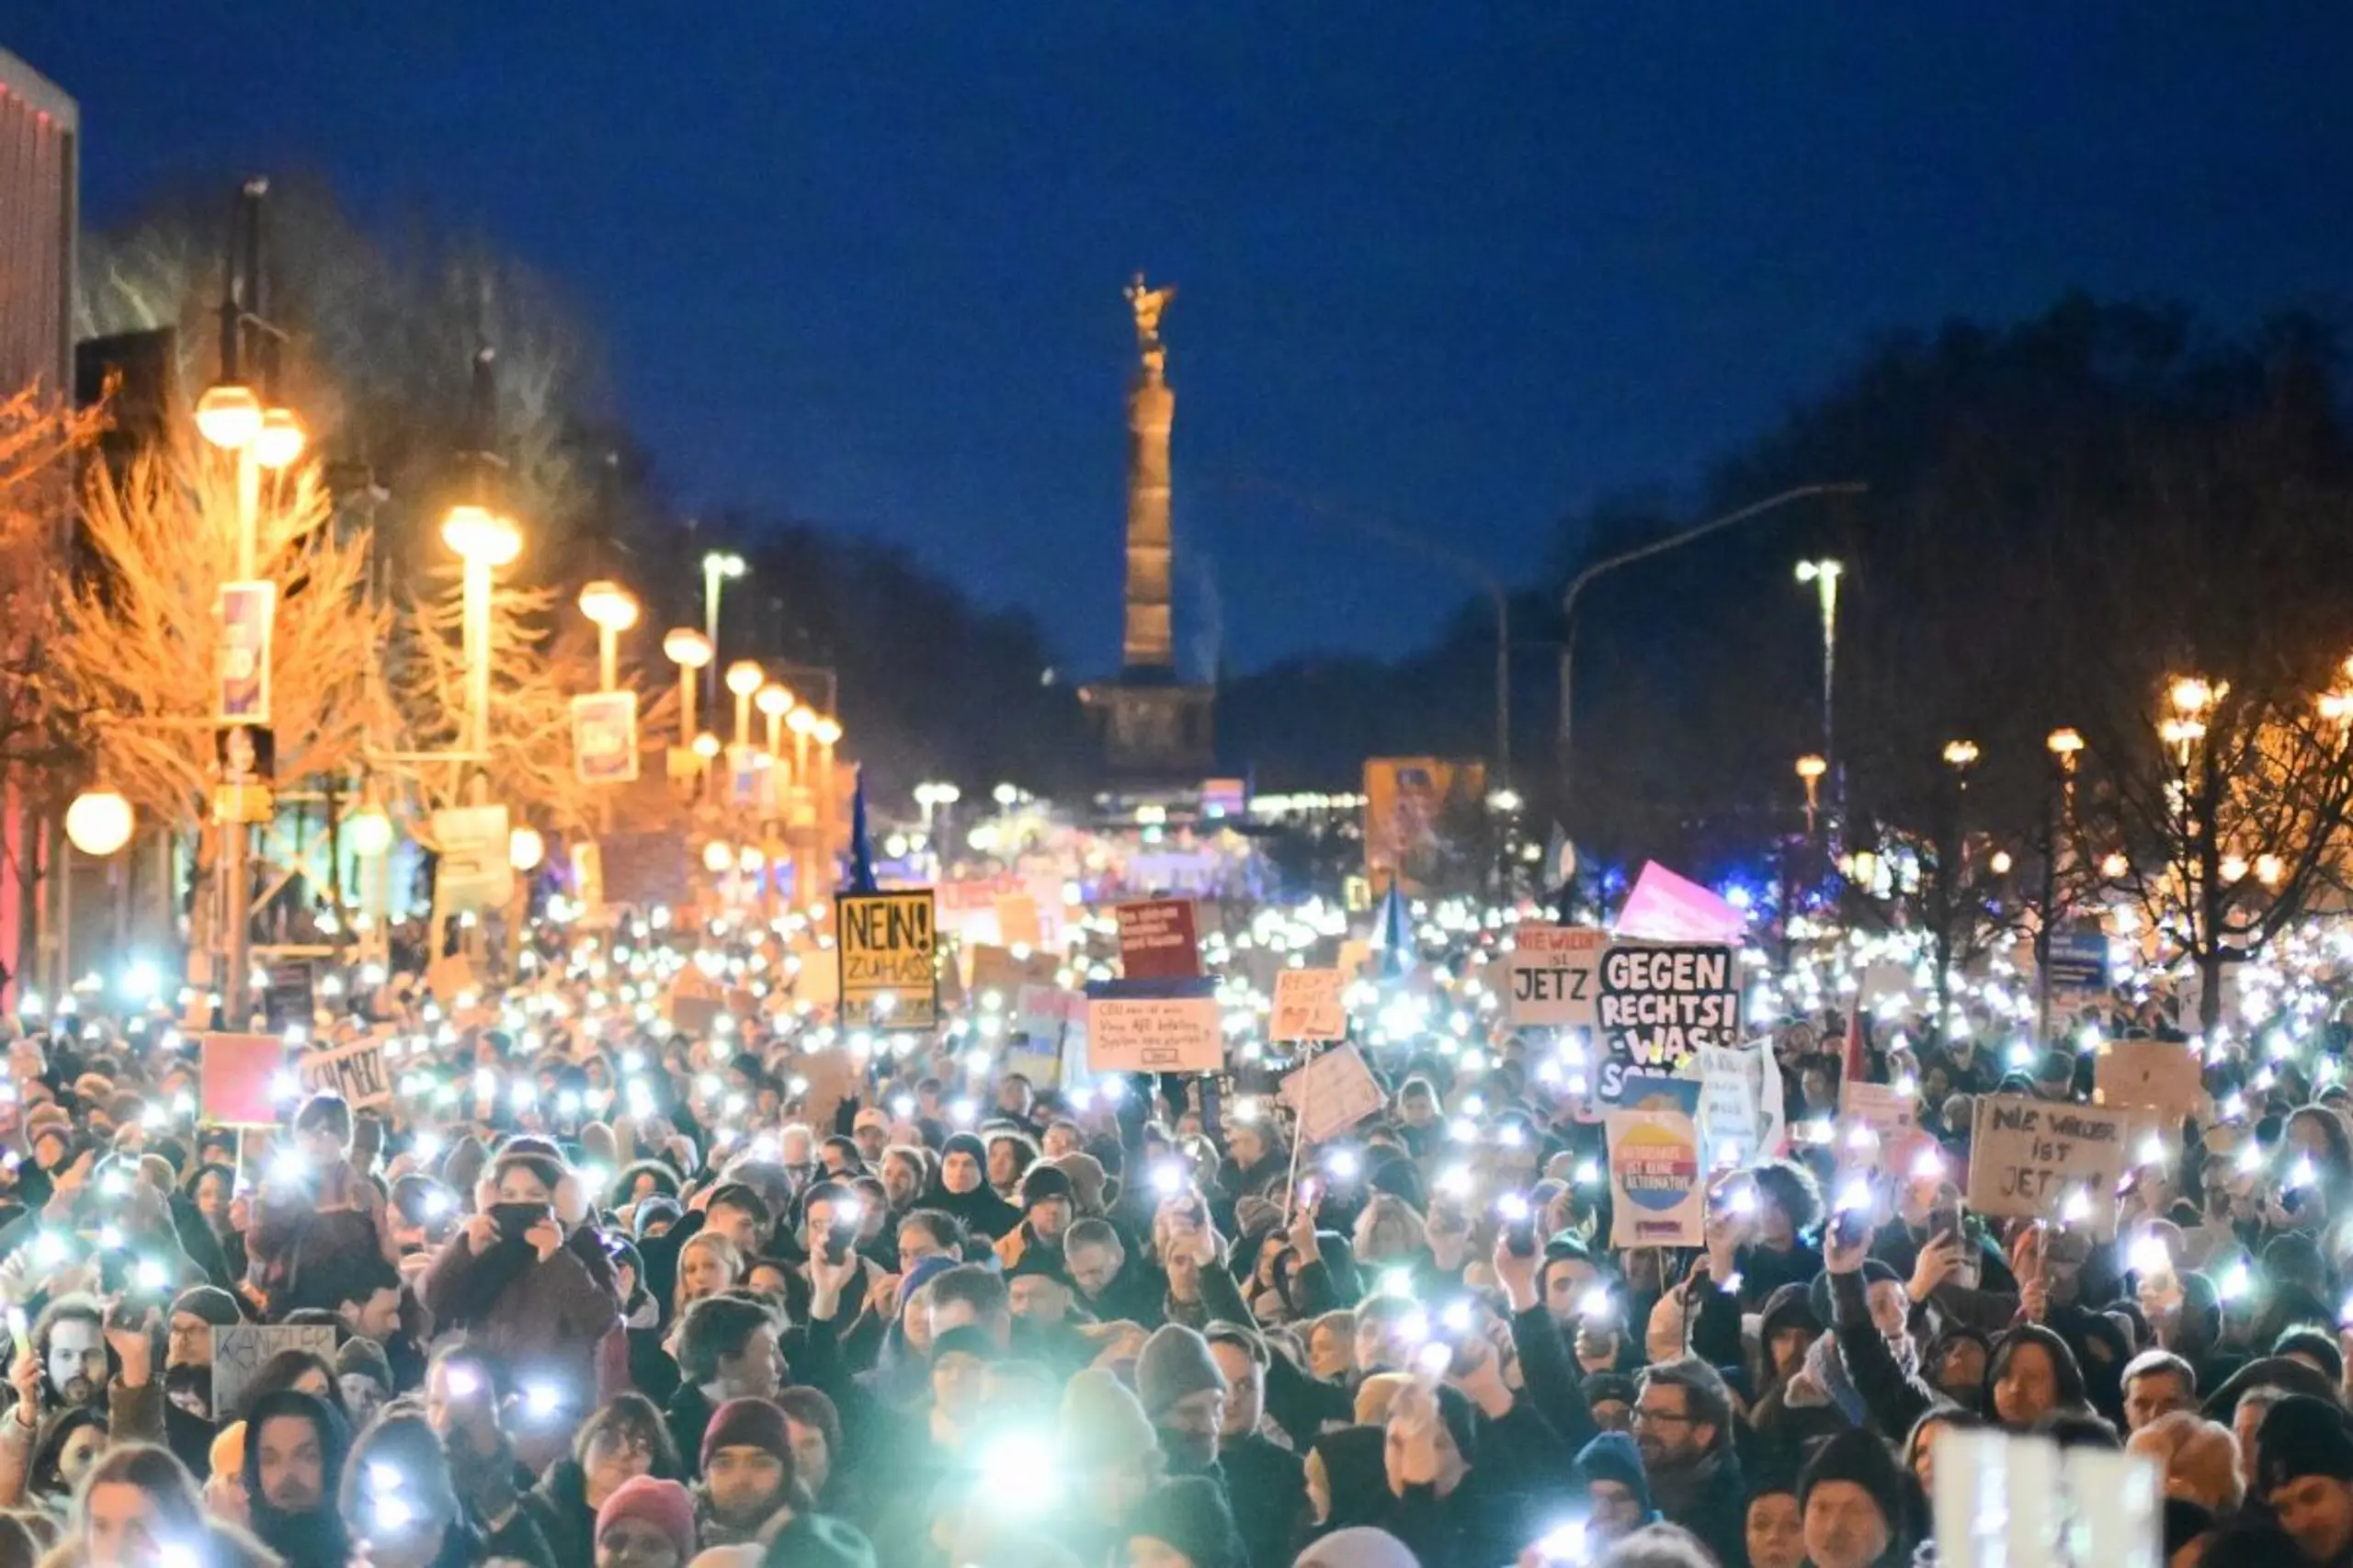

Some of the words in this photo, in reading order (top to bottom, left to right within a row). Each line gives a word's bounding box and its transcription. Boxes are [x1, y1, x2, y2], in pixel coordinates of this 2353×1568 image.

[847, 903, 928, 950] NEIN!
[1608, 952, 1725, 991] GEGEN
[1601, 994, 1737, 1028] RECHTS!
[1993, 1106, 2039, 1131] NIE
